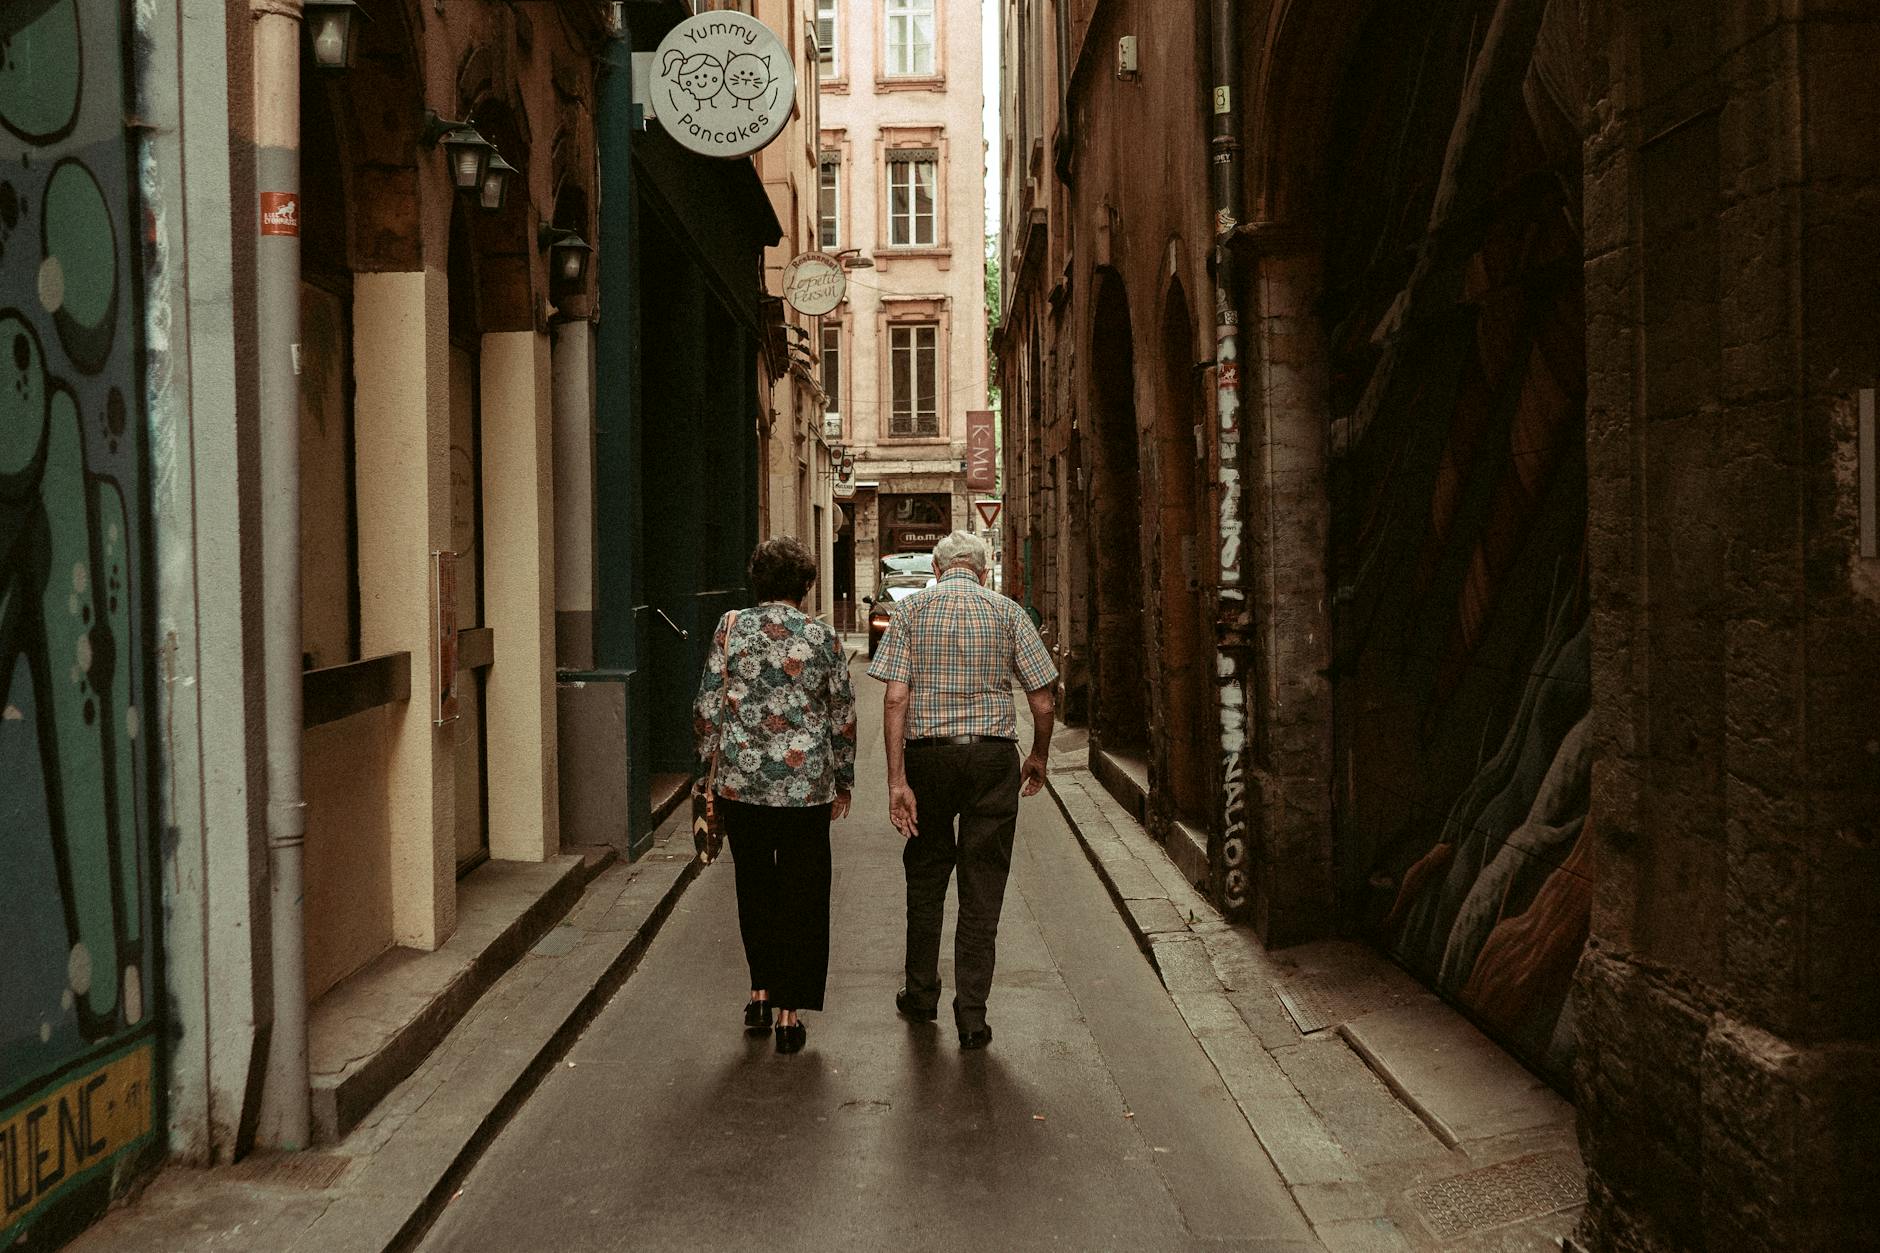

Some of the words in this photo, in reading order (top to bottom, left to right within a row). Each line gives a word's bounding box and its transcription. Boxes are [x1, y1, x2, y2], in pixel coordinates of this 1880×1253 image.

[684, 23, 758, 45] Yummy
[677, 113, 769, 144] Pancakes
[972, 424, 990, 480] K-MU
